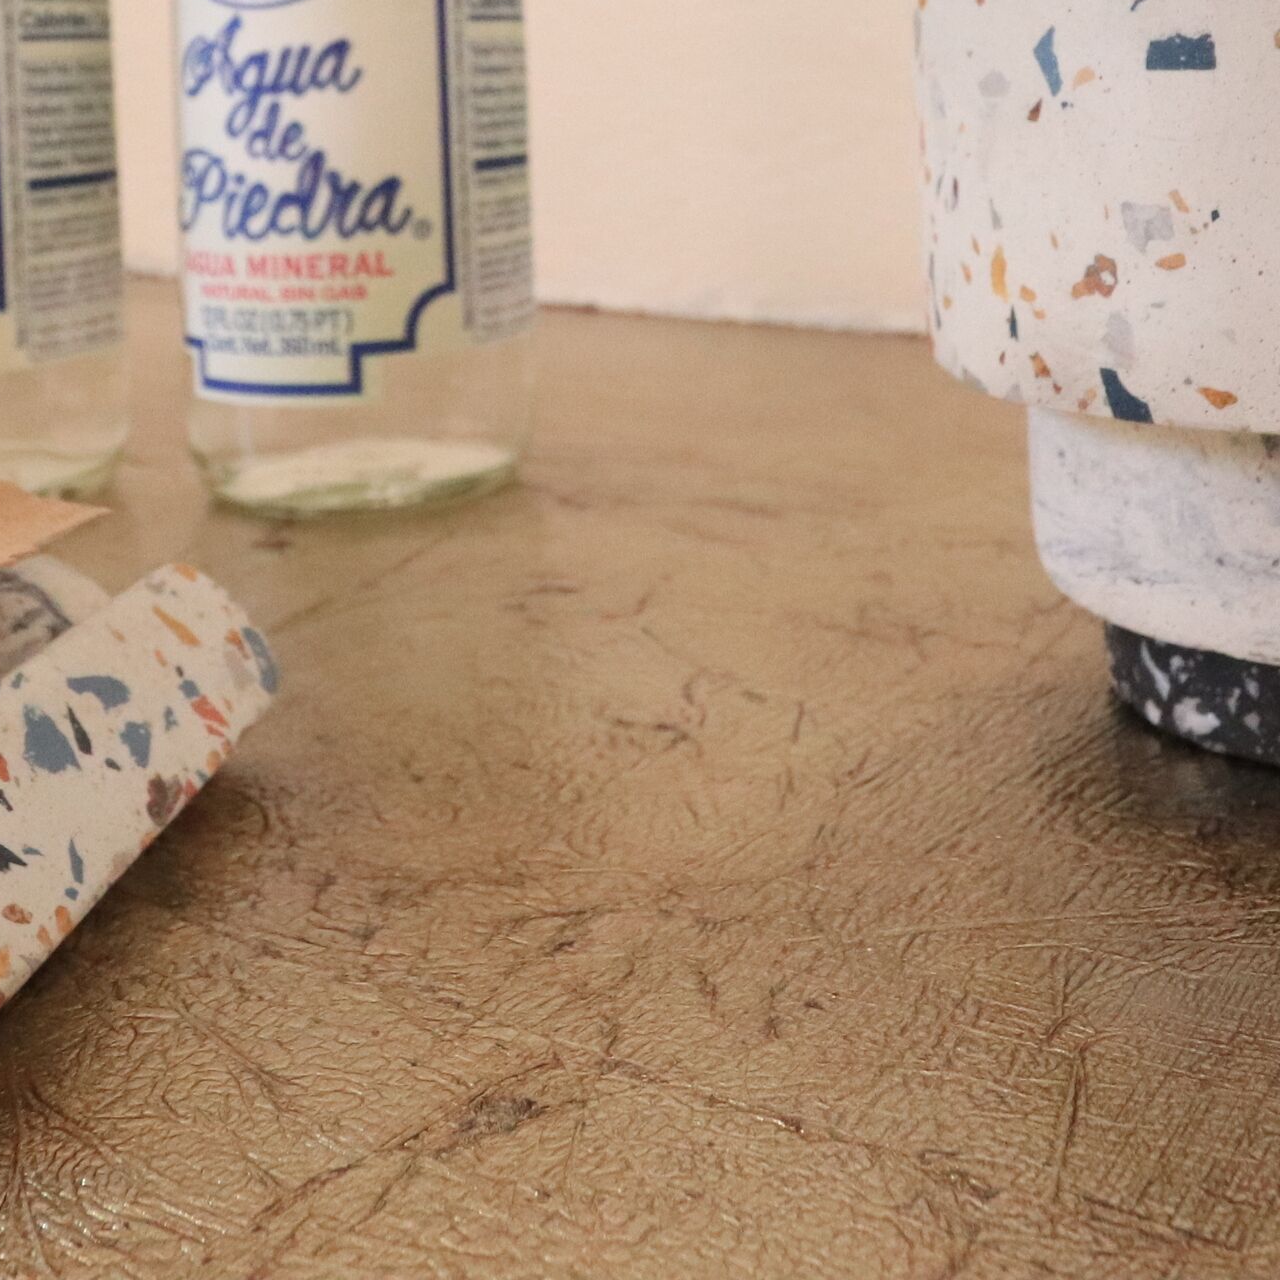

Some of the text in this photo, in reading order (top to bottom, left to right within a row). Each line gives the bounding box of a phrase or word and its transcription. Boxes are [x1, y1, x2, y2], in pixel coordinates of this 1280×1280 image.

[182, 15, 361, 137] Agua
[246, 101, 305, 160] de
[181, 149, 412, 239] Piedra
[246, 250, 395, 279] MINERAL
